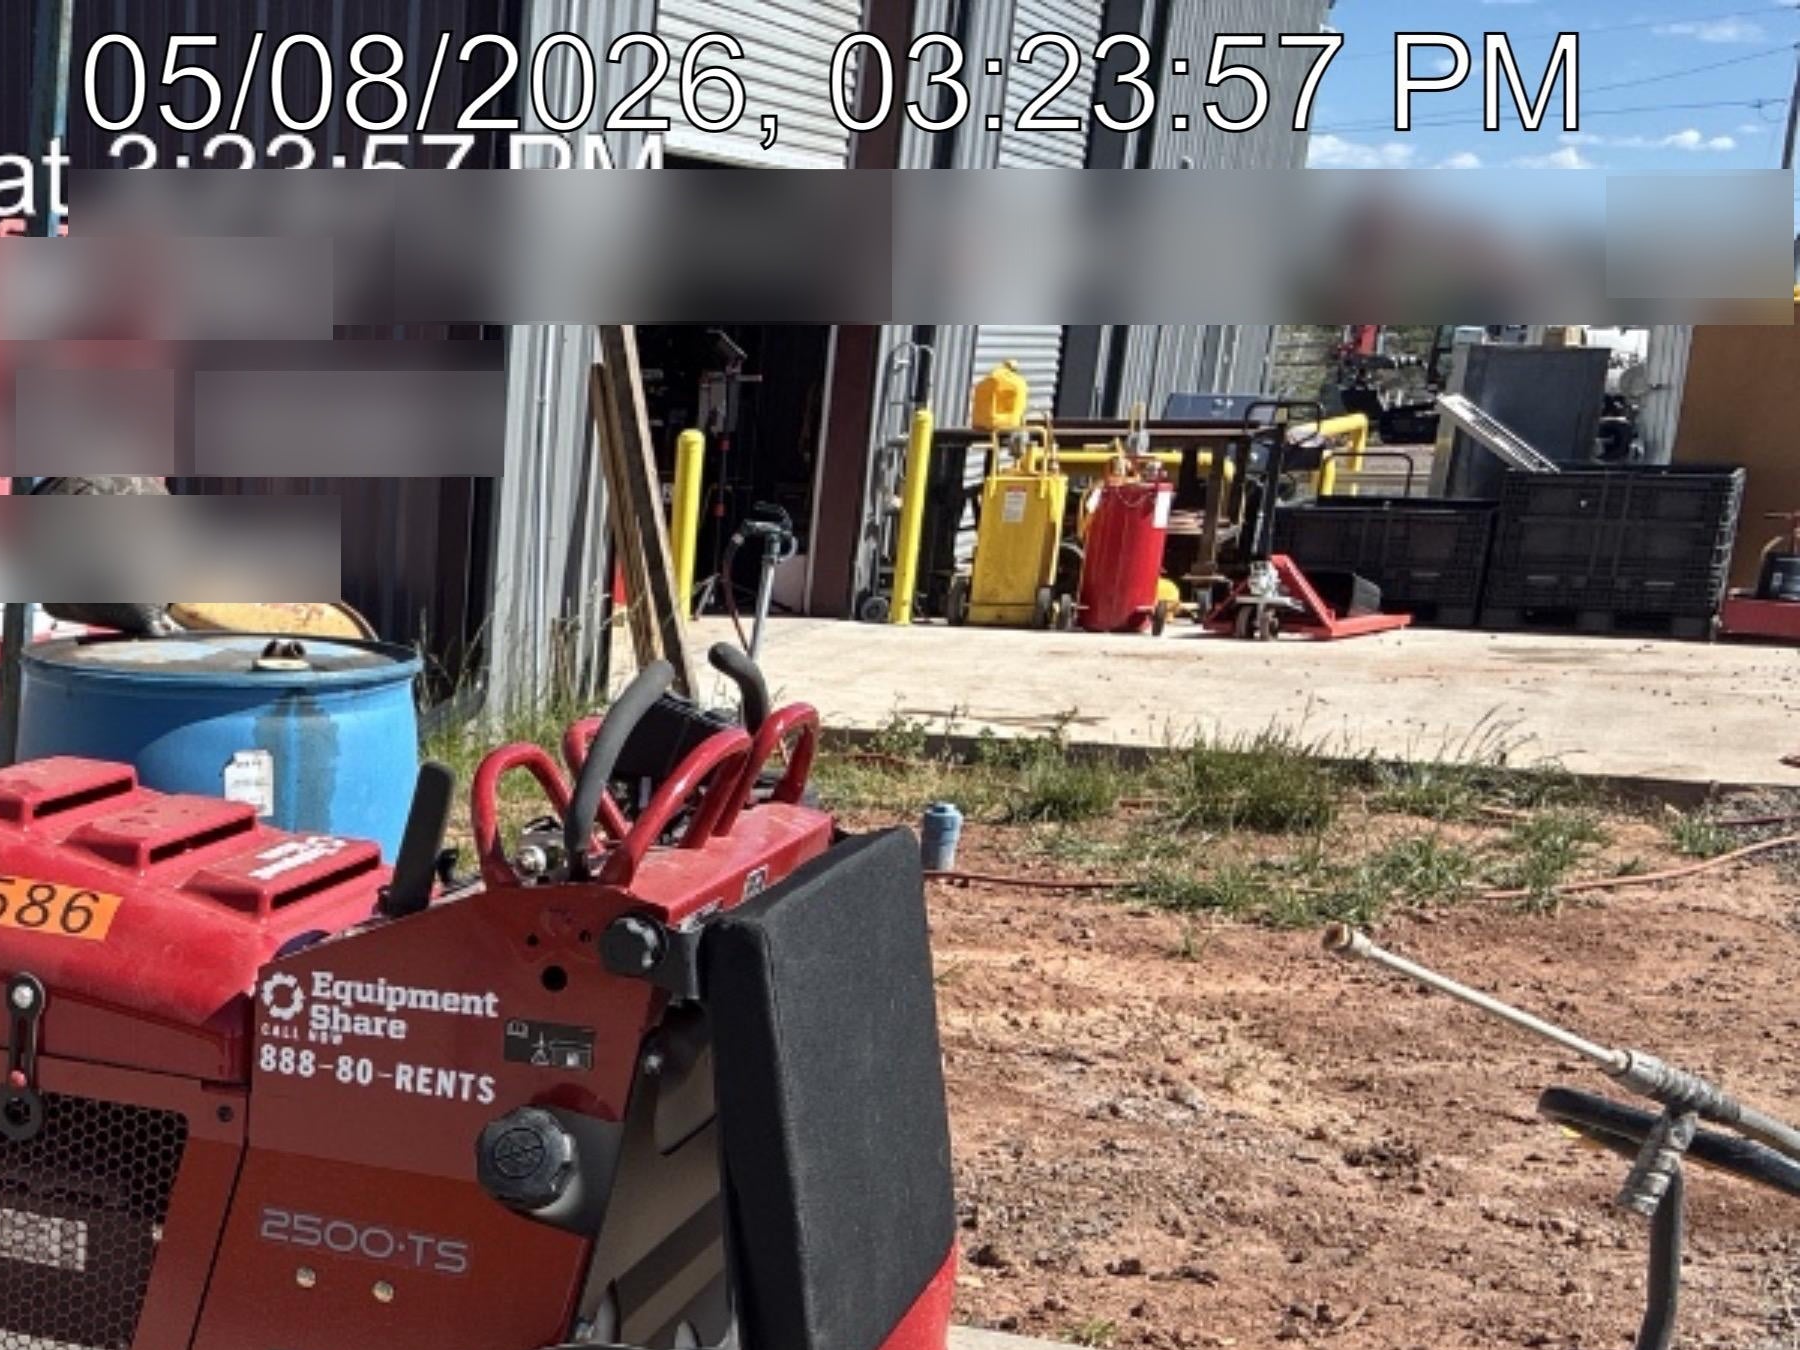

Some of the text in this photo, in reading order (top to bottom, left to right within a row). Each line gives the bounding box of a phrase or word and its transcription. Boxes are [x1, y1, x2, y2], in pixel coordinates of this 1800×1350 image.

[311, 971, 499, 1018] Equipment
[310, 1004, 408, 1040] Share
[260, 1043, 496, 1105] 888-80-RENTS
